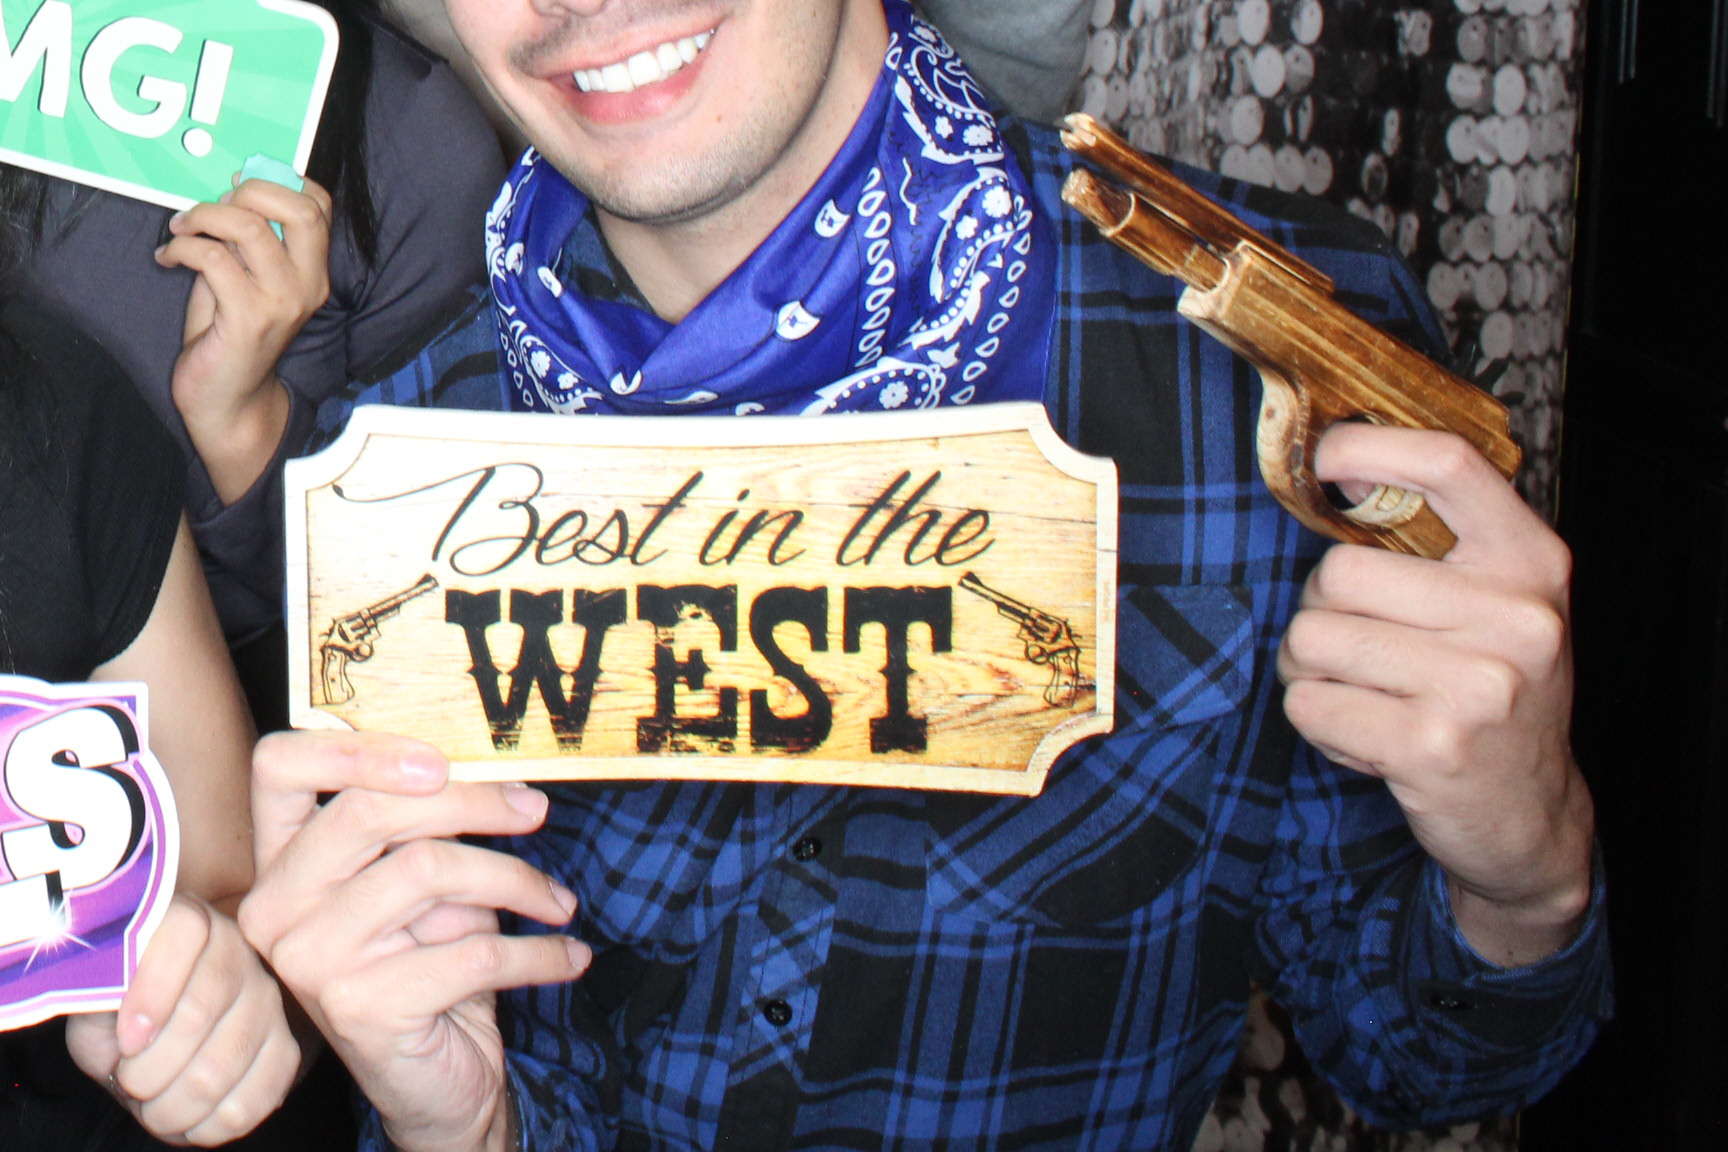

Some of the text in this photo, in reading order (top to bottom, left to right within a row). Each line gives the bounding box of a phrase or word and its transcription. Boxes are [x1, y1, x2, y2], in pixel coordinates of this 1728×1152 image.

[332, 462, 996, 575] Best in the
[444, 583, 954, 754] WEST
